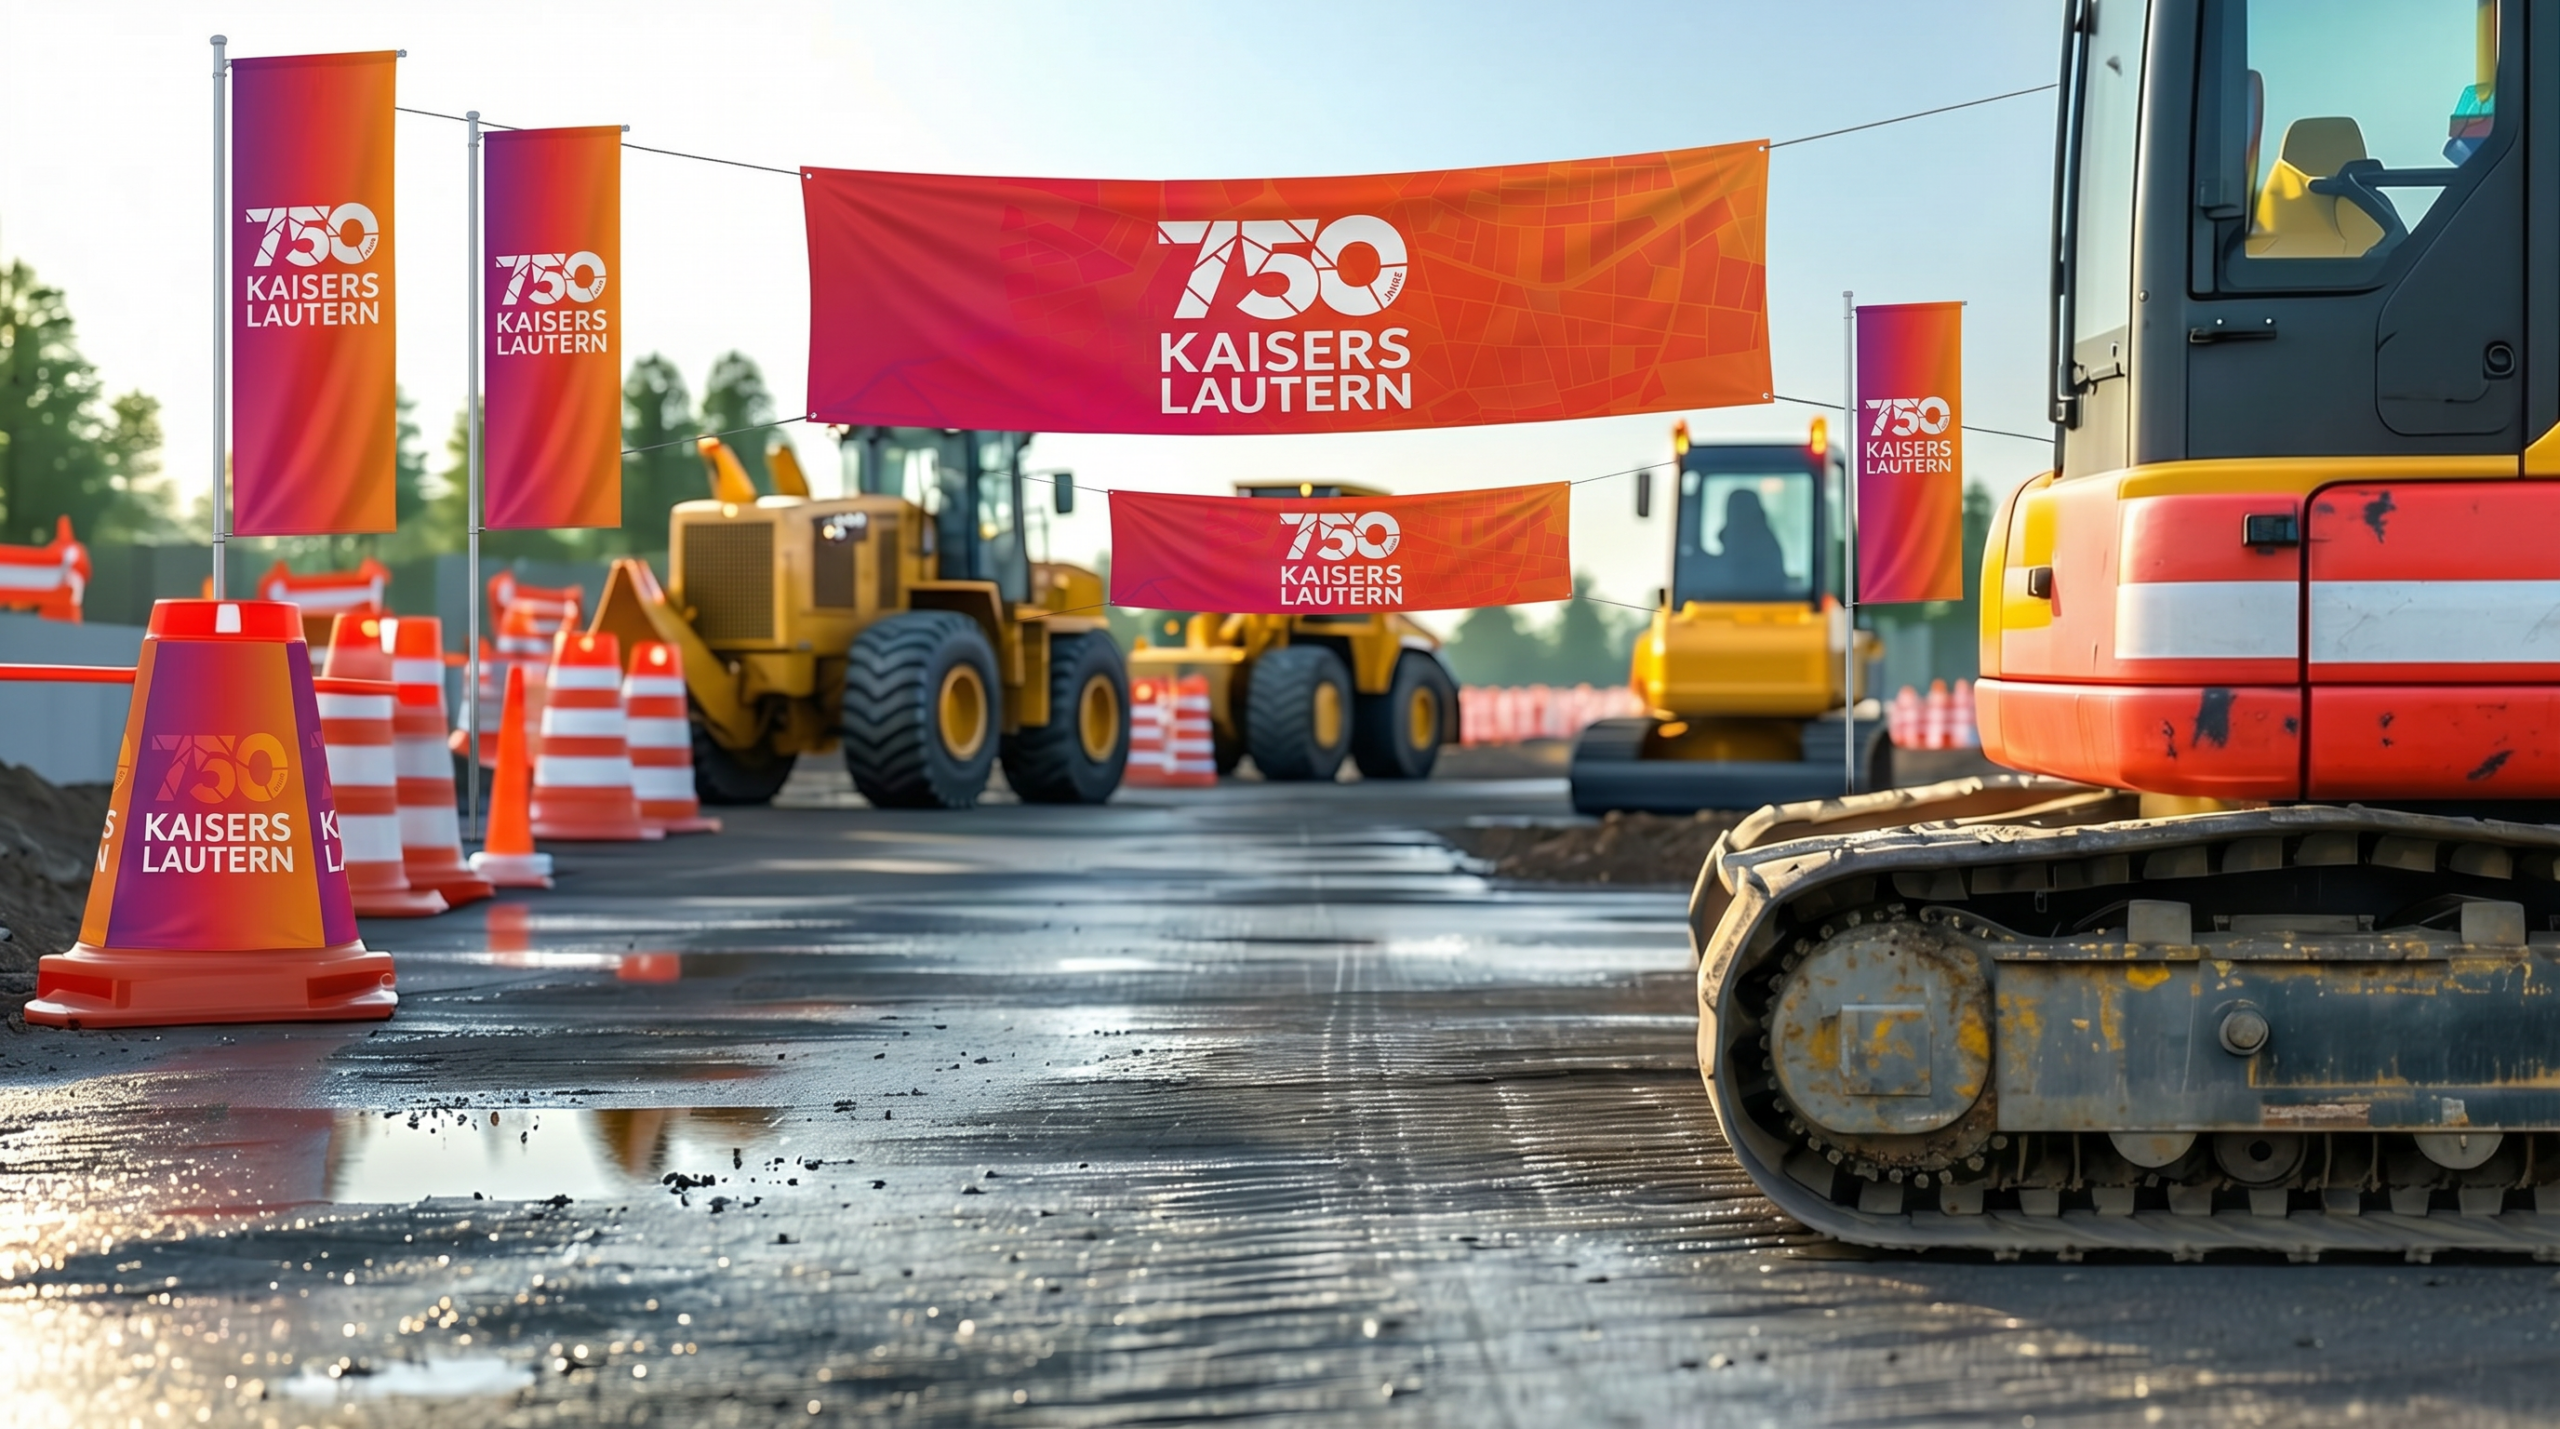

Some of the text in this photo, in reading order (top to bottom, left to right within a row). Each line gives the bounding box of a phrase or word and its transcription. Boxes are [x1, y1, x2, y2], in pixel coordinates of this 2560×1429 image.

[246, 203, 379, 267] 750
[495, 251, 607, 305] 750
[1158, 214, 1407, 320] 750
[247, 273, 379, 300] KAISERS
[247, 302, 379, 328] LAUTERN
[497, 309, 607, 333] KAISERS
[497, 333, 607, 355] LAUTERN
[1161, 328, 1411, 372] KAISERS
[1161, 373, 1412, 413] LAUTERN
[1865, 396, 1950, 436] 750
[1866, 440, 1951, 458] KAISERS
[1866, 459, 1951, 474] LAUTERN
[1279, 511, 1400, 561] 750
[1281, 565, 1402, 585] KAISERS
[1281, 586, 1402, 605] LAUTERN
[151, 732, 288, 803] 750
[144, 812, 291, 842] KAISERS
[142, 846, 293, 873] LAUTERN
